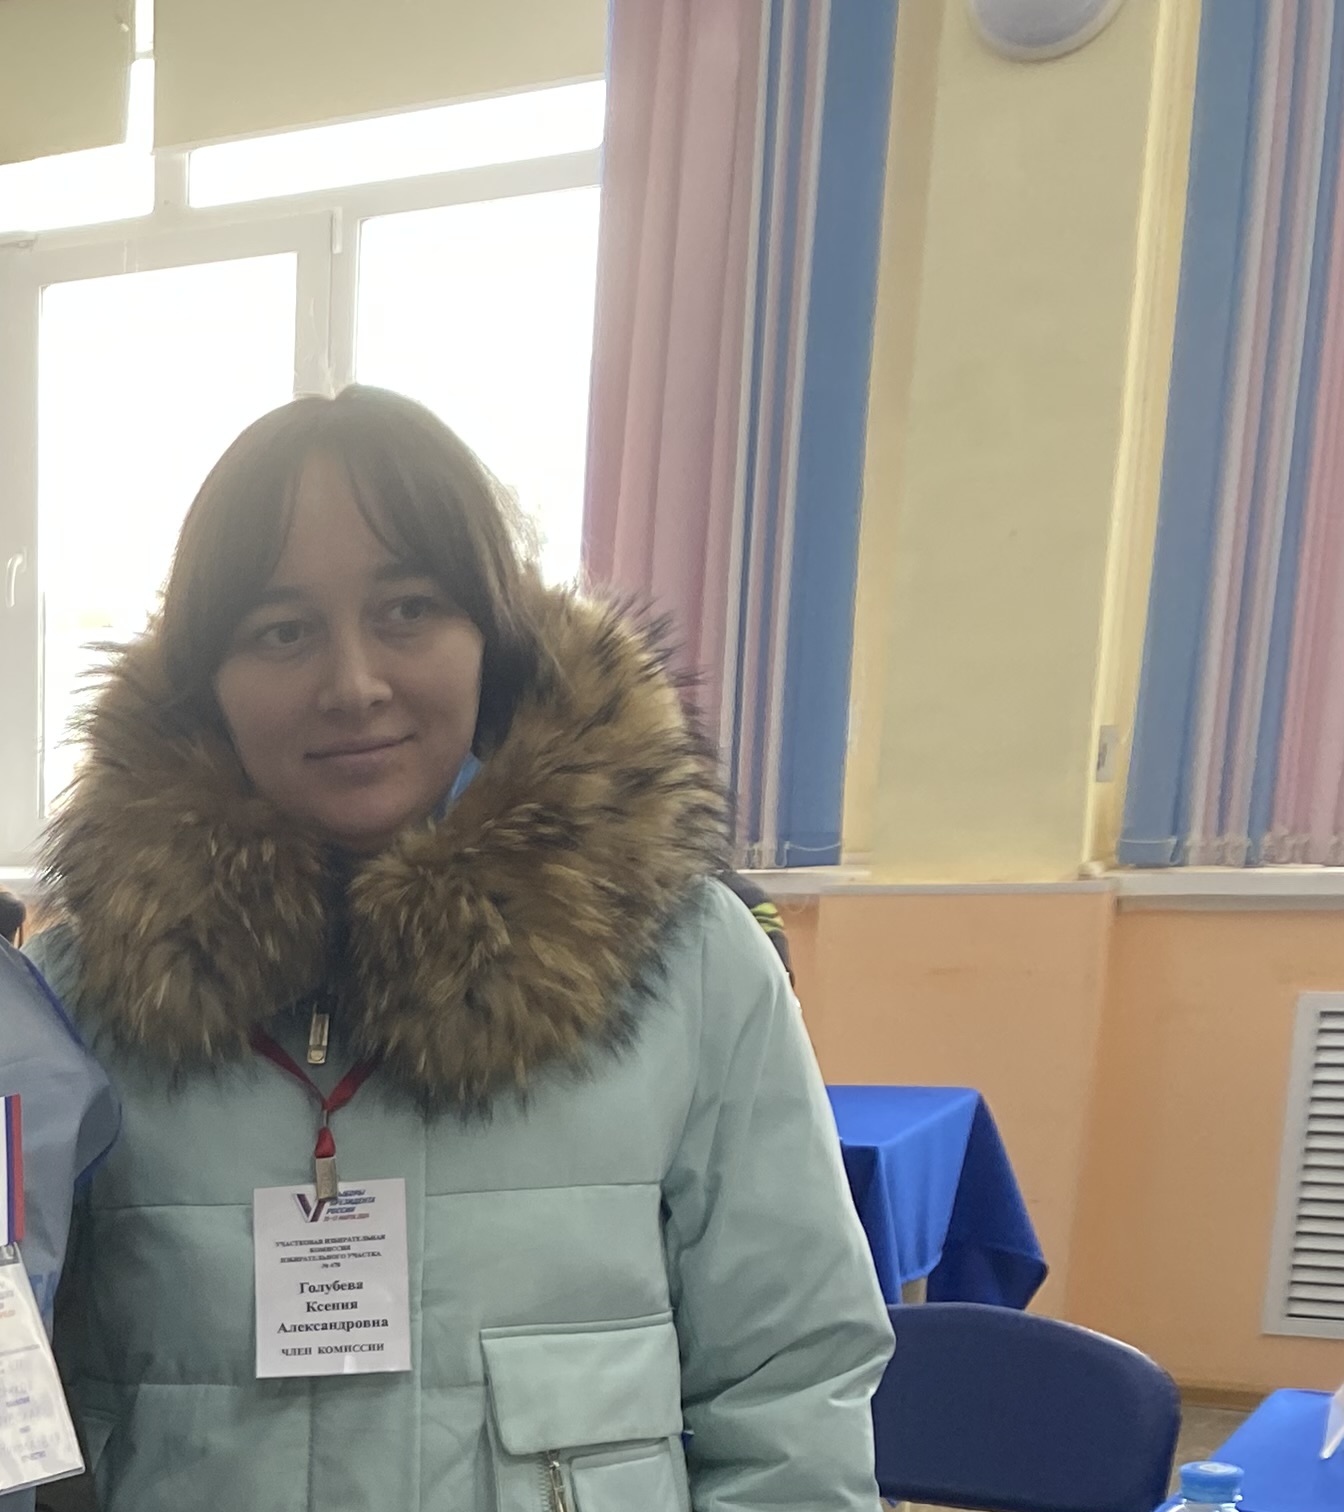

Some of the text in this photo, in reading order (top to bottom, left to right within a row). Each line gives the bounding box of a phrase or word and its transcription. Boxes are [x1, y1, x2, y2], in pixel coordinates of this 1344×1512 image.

[299, 1280, 364, 1295] Голубева
[306, 1301, 359, 1313] Ксения
[277, 1318, 389, 1334] Александровна
[281, 1343, 385, 1356] ЧЛЕН КОМИССИИ
